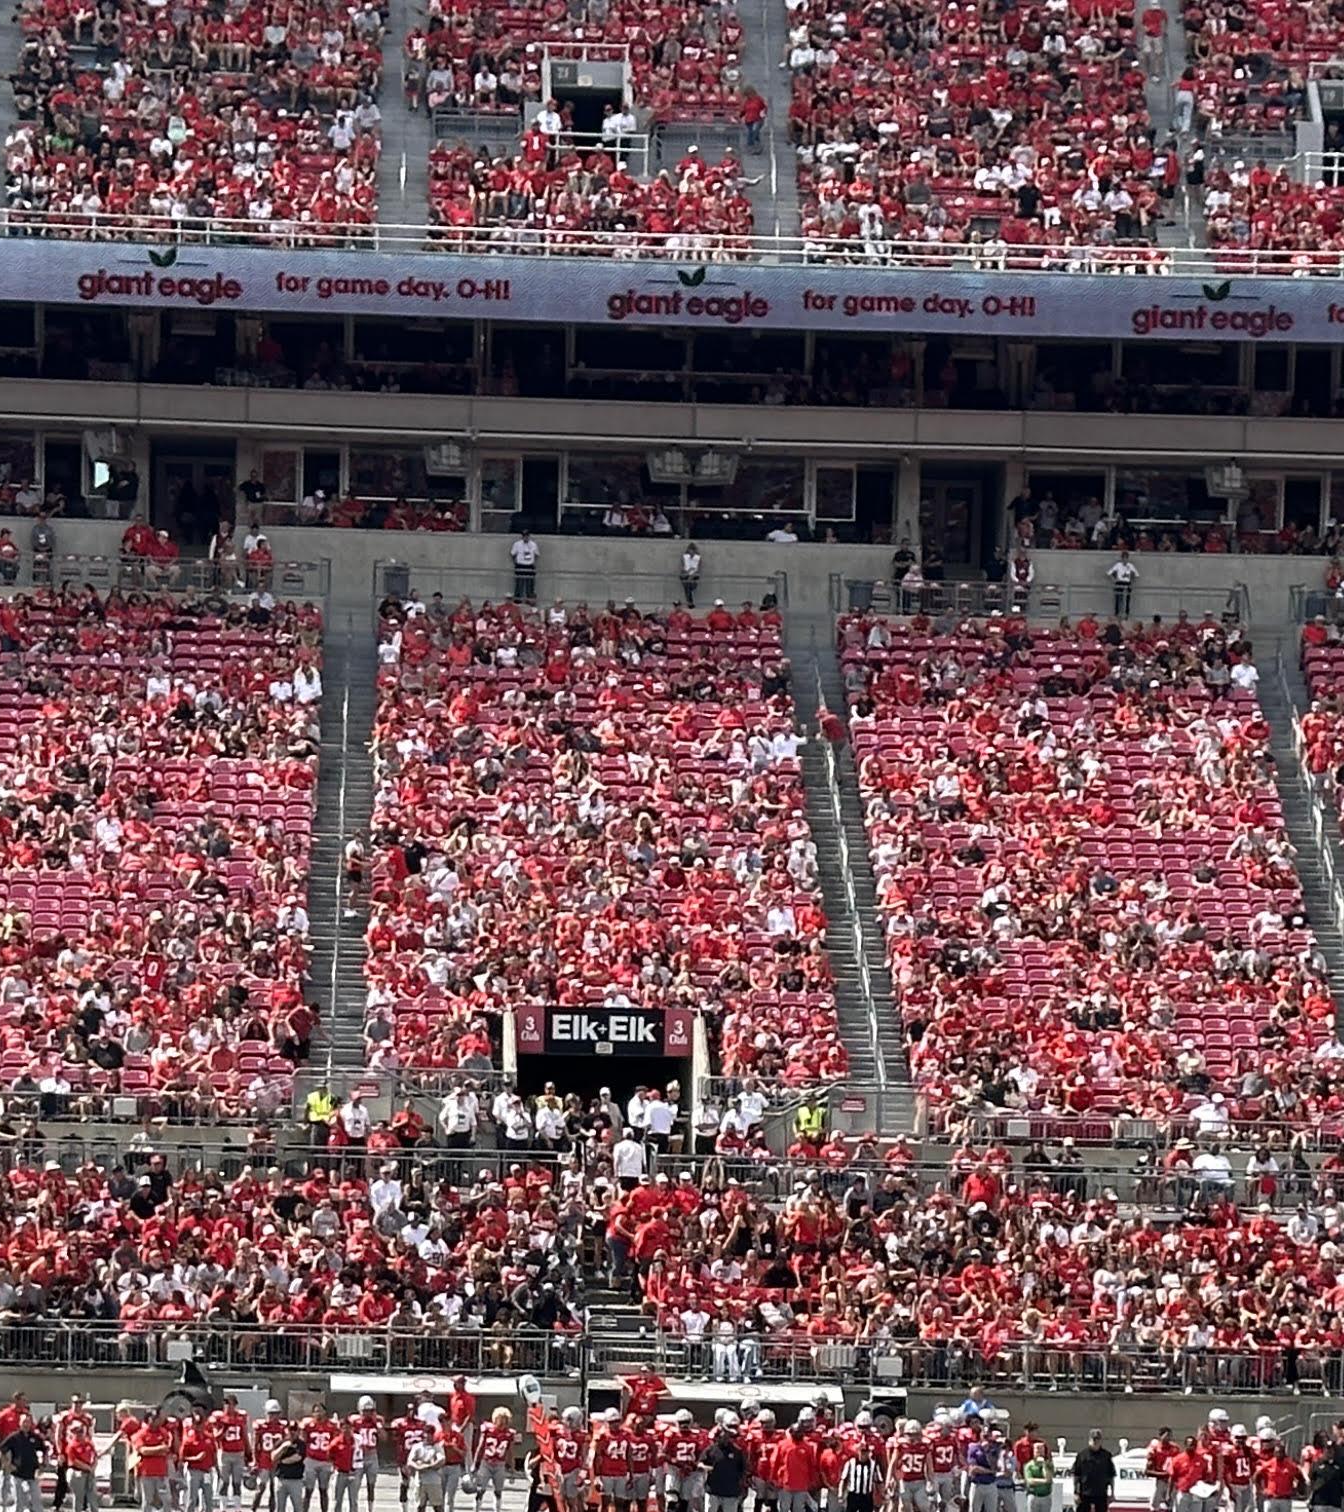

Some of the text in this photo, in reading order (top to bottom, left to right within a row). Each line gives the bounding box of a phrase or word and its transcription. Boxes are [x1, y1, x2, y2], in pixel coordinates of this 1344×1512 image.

[78, 270, 243, 305] giant eagle
[275, 270, 511, 301] for game day. O-H!
[607, 288, 768, 321] giant eagle
[802, 287, 1036, 317] for game day. O-H!
[1131, 303, 1294, 337] giant eagle
[524, 1016, 535, 1031] 3
[674, 1020, 684, 1035] 3
[484, 1437, 507, 1457] 34
[904, 1453, 925, 1473] 35
